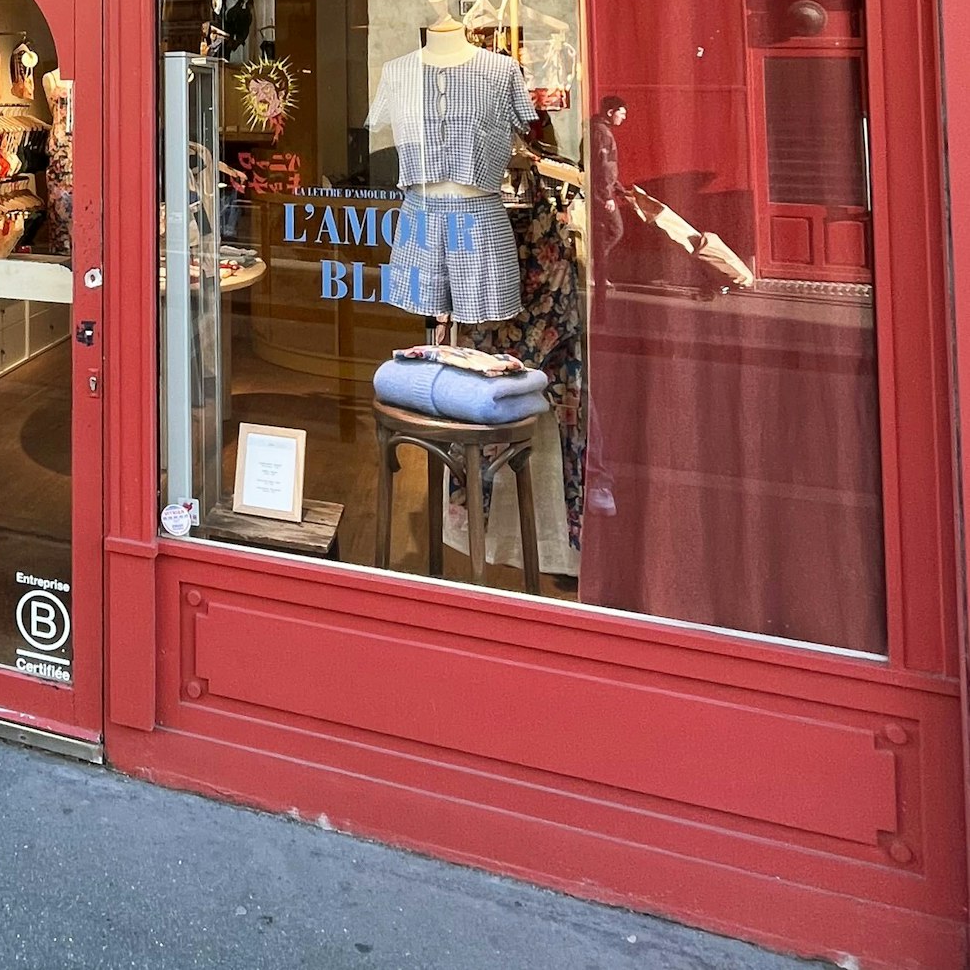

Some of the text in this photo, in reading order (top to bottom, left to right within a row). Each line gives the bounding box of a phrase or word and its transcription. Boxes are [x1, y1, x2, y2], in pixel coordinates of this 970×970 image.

[307, 187, 343, 198] LETTRE
[345, 189, 387, 200] D'AMOUR
[283, 203, 476, 254] L'AMOUR
[16, 571, 70, 592] Entreprise
[16, 658, 70, 682] Certifiée
